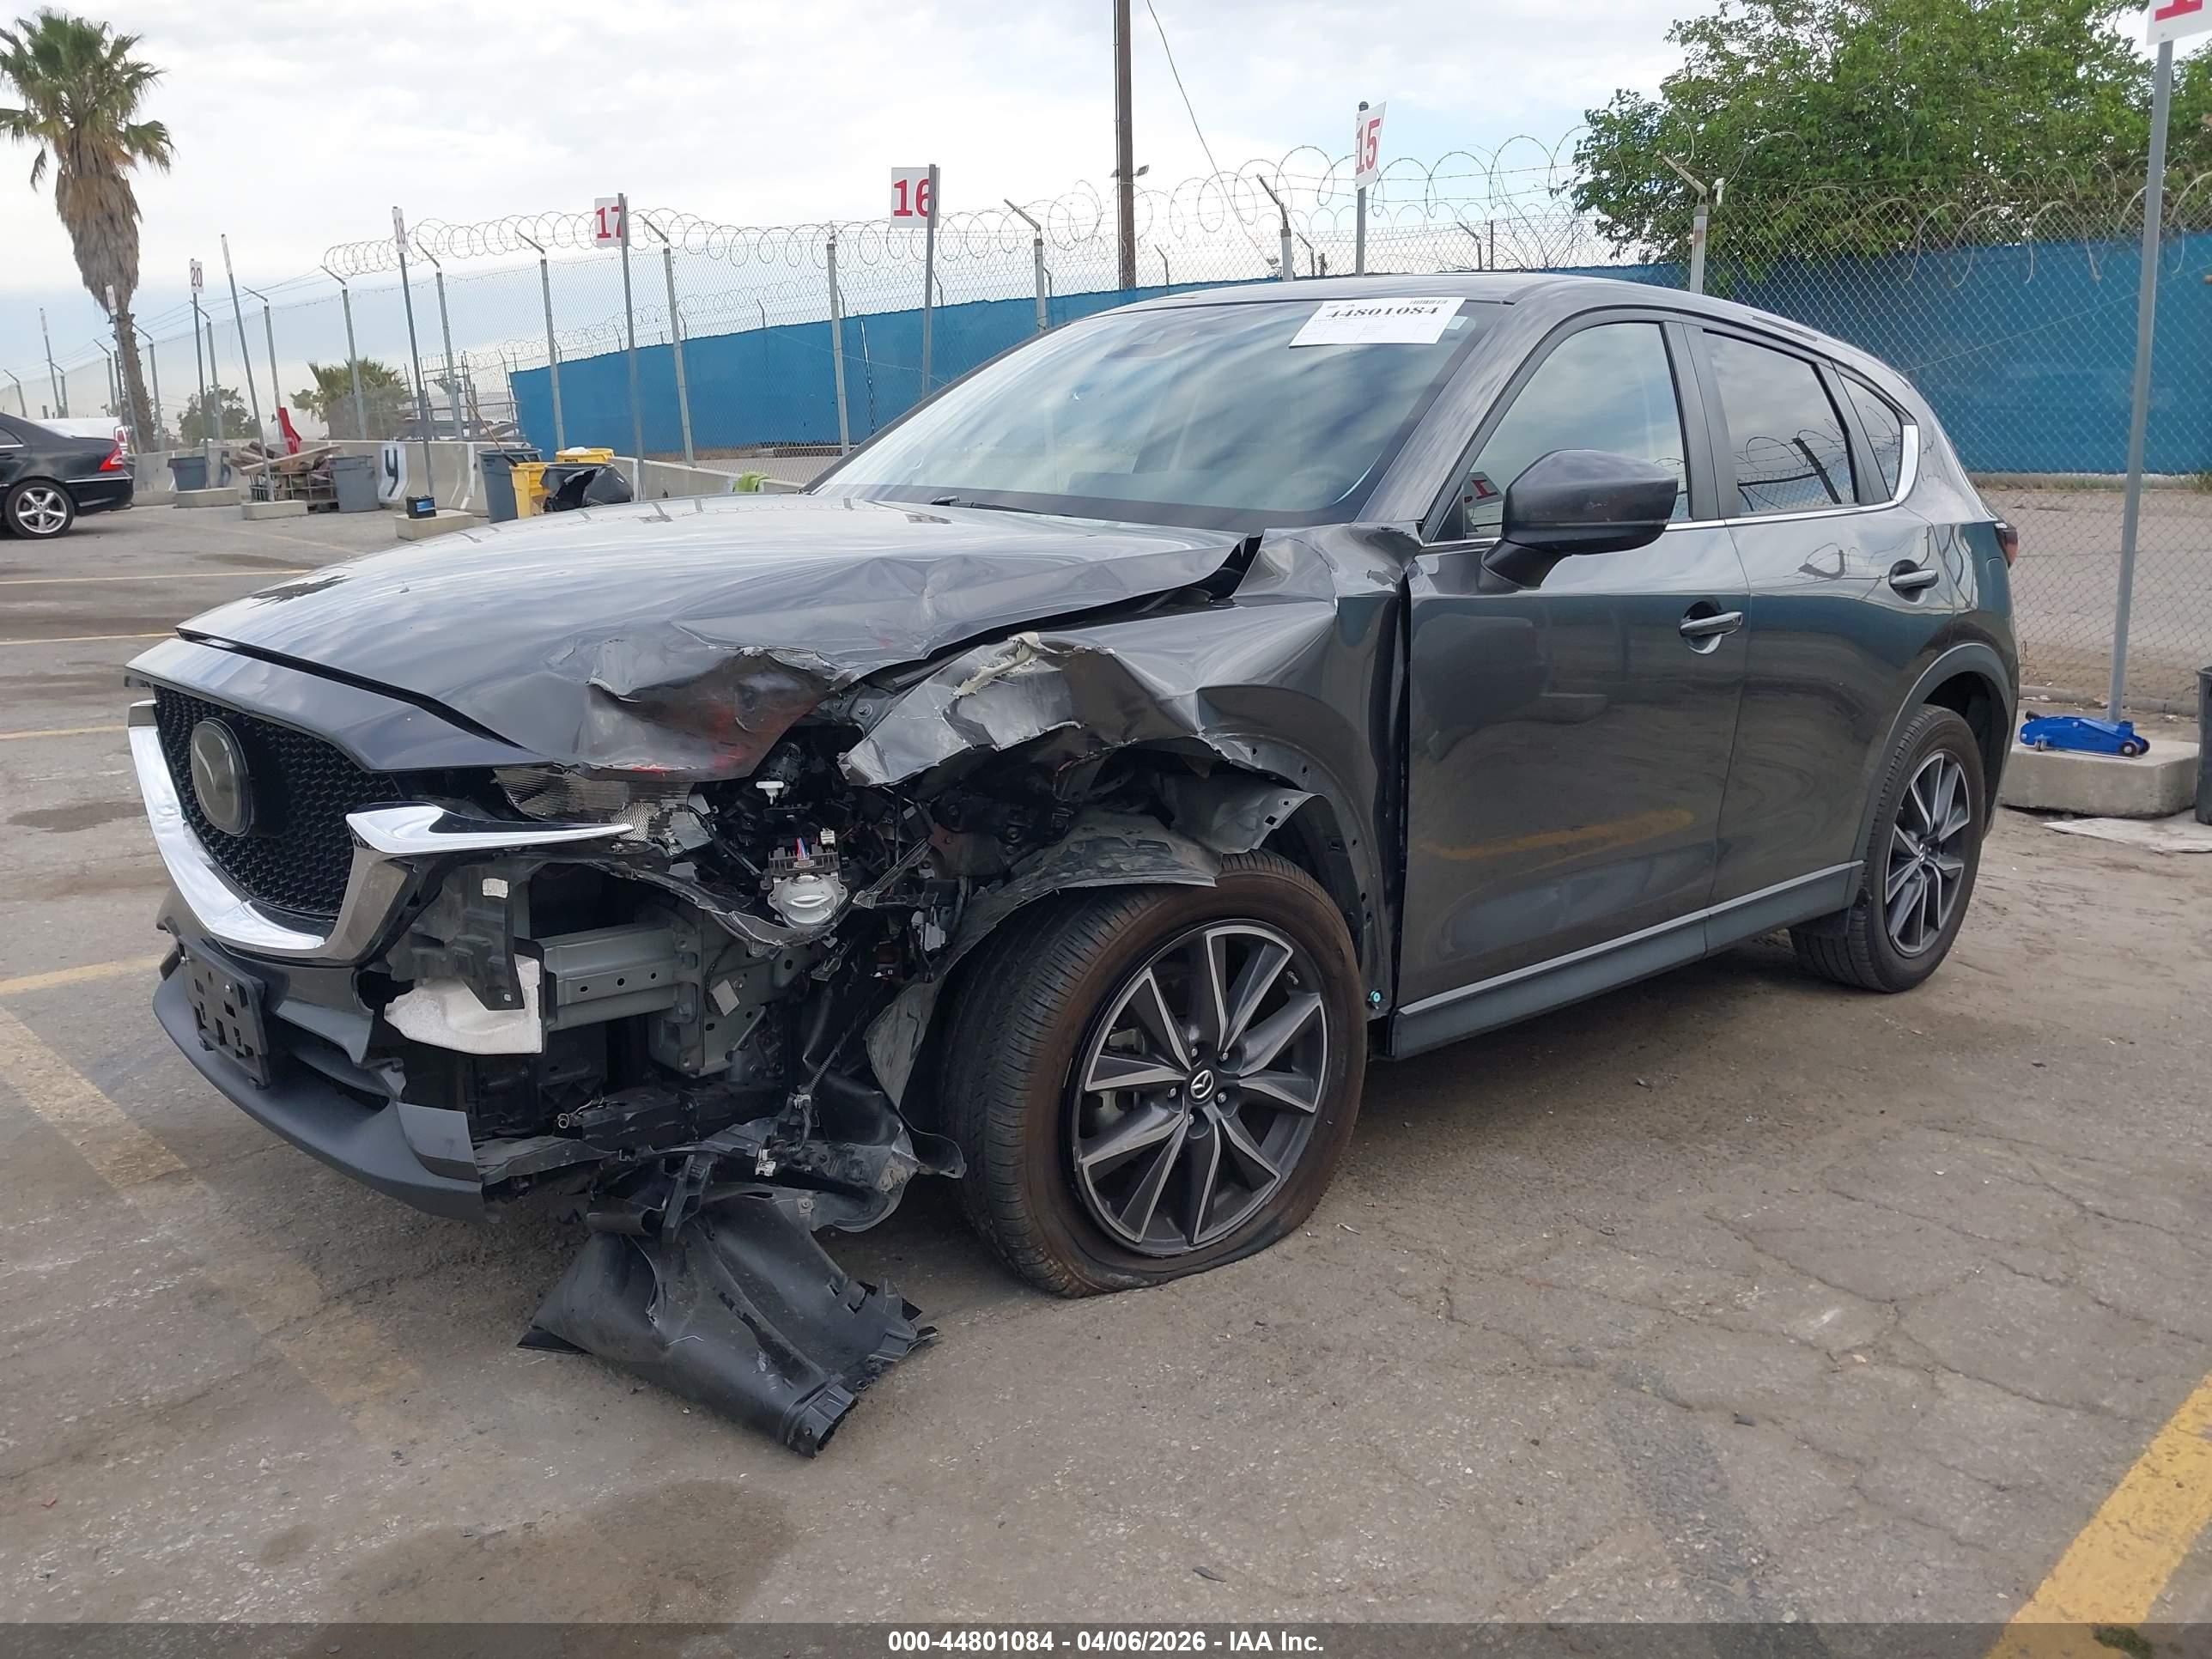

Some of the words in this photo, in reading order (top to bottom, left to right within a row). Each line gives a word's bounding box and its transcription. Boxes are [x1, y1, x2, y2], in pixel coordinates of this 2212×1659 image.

[1357, 118, 1381, 175] 15
[894, 179, 931, 217] 16
[394, 218, 406, 244] 18
[191, 267, 203, 288] 20
[1326, 307, 1439, 318] 44801084
